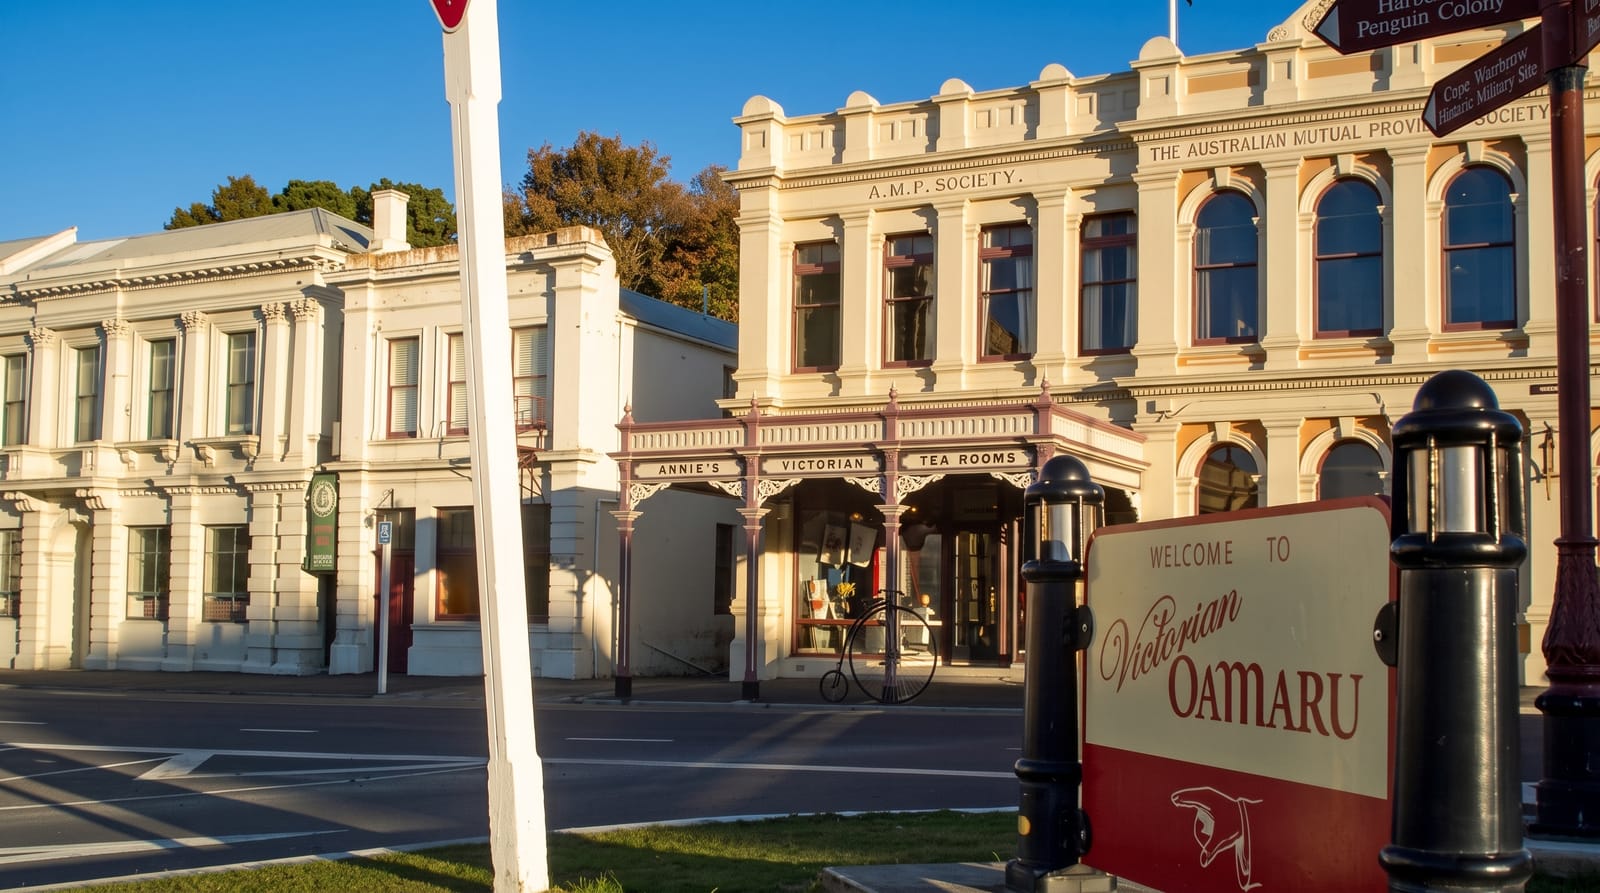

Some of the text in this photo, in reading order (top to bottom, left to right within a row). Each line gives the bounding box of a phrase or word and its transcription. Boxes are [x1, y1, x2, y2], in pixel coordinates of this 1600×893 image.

[1357, 0, 1504, 38] Penguin Colony
[1476, 75, 1515, 106] Military
[1518, 62, 1538, 83] Site
[1150, 144, 1181, 162] THE
[1187, 134, 1286, 157] AUSTRALIAN
[1293, 127, 1361, 146] MUTUAL
[868, 169, 1023, 199] A.M.P. SOCIETY.
[658, 452, 1016, 475] ANNIE'S VICTORIAN TEA ROOMS
[1150, 535, 1290, 569] WELCOME TO
[1099, 589, 1243, 695] Victorian
[1168, 654, 1364, 740] OAMARU
